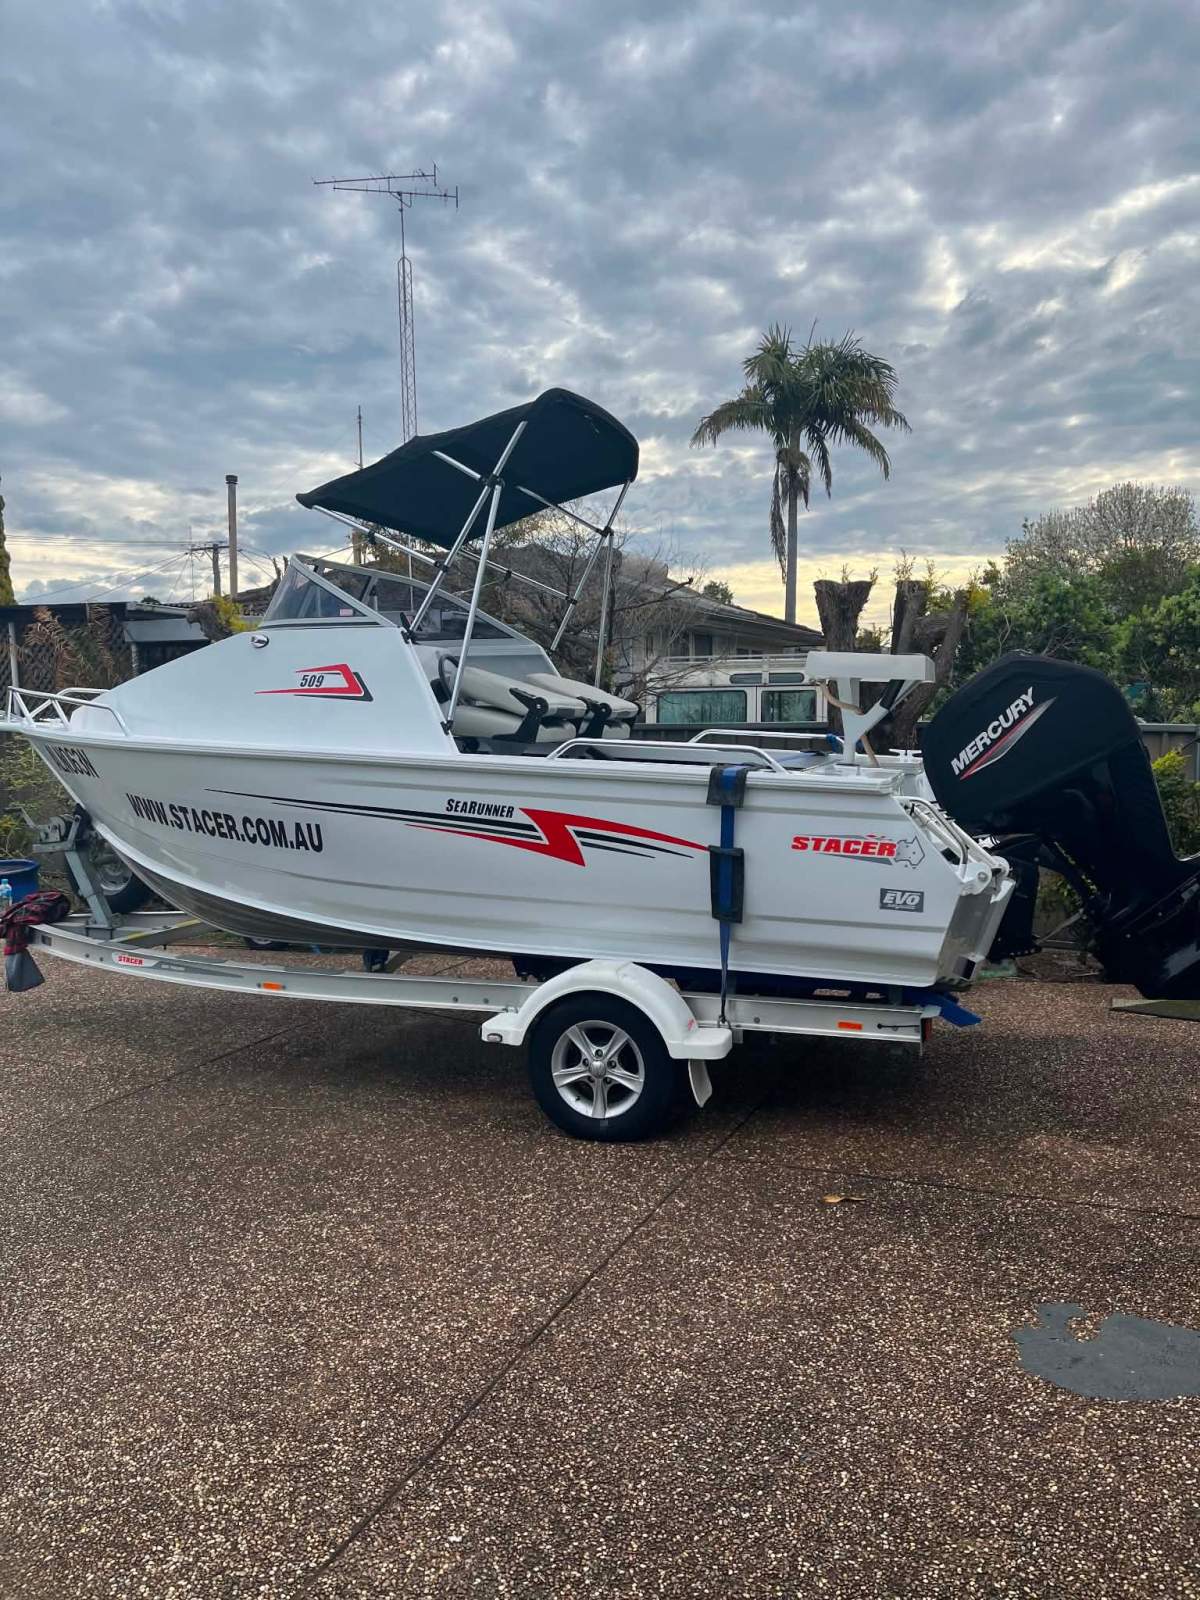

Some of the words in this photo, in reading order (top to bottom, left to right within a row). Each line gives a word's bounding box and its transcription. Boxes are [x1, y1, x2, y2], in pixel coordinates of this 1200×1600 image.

[300, 674, 325, 687] 509
[951, 686, 1034, 775] MERCURY
[126, 792, 324, 853] WWW.STACER.COM.AU
[791, 836, 897, 857] STACER
[882, 891, 921, 905] EVO
